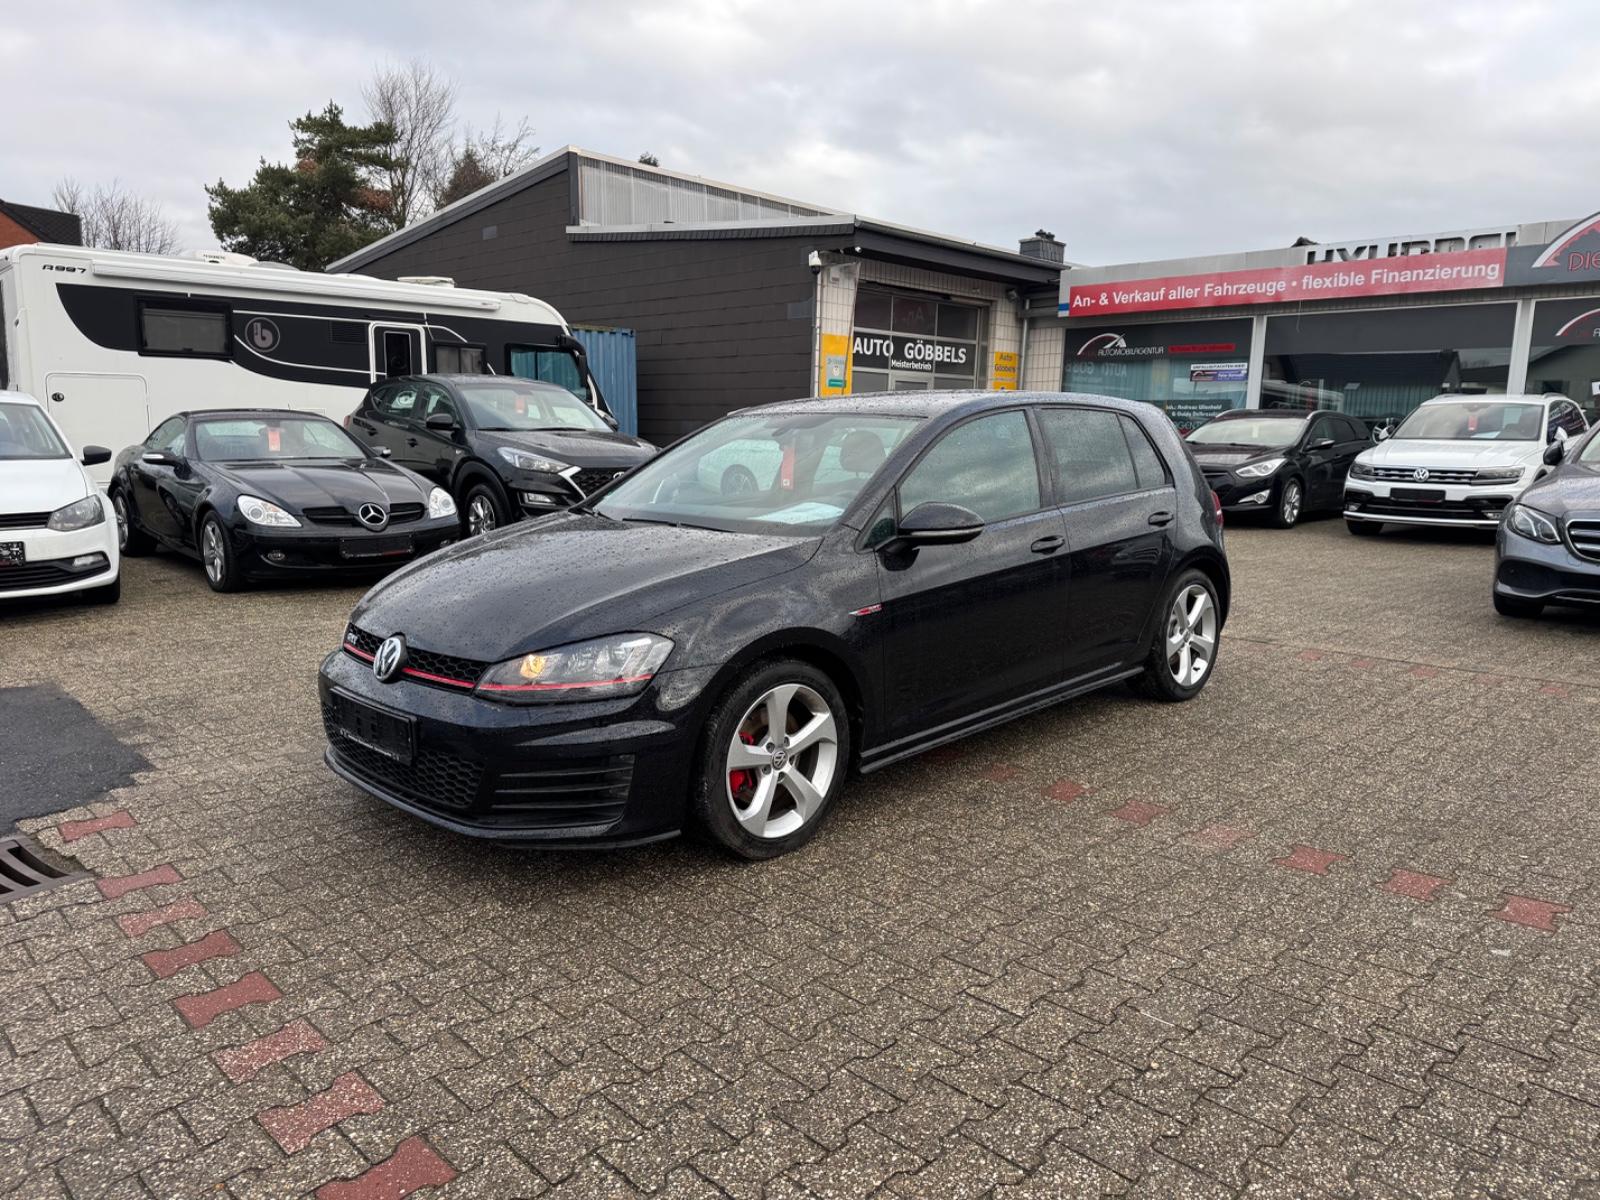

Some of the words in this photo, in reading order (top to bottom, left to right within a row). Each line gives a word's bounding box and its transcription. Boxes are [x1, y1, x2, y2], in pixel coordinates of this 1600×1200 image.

[1072, 294, 1096, 308] An-
[1099, 292, 1109, 306] &
[1113, 287, 1166, 304] Verkauf
[1168, 285, 1200, 301] aller
[1204, 280, 1287, 297] Fahrzeuge
[1302, 272, 1366, 290] flexible
[1371, 263, 1500, 285] Finanzierung
[853, 337, 894, 357] AUTO
[904, 340, 967, 364] GÖBBELS
[891, 359, 932, 371] Meisterbetrieb
